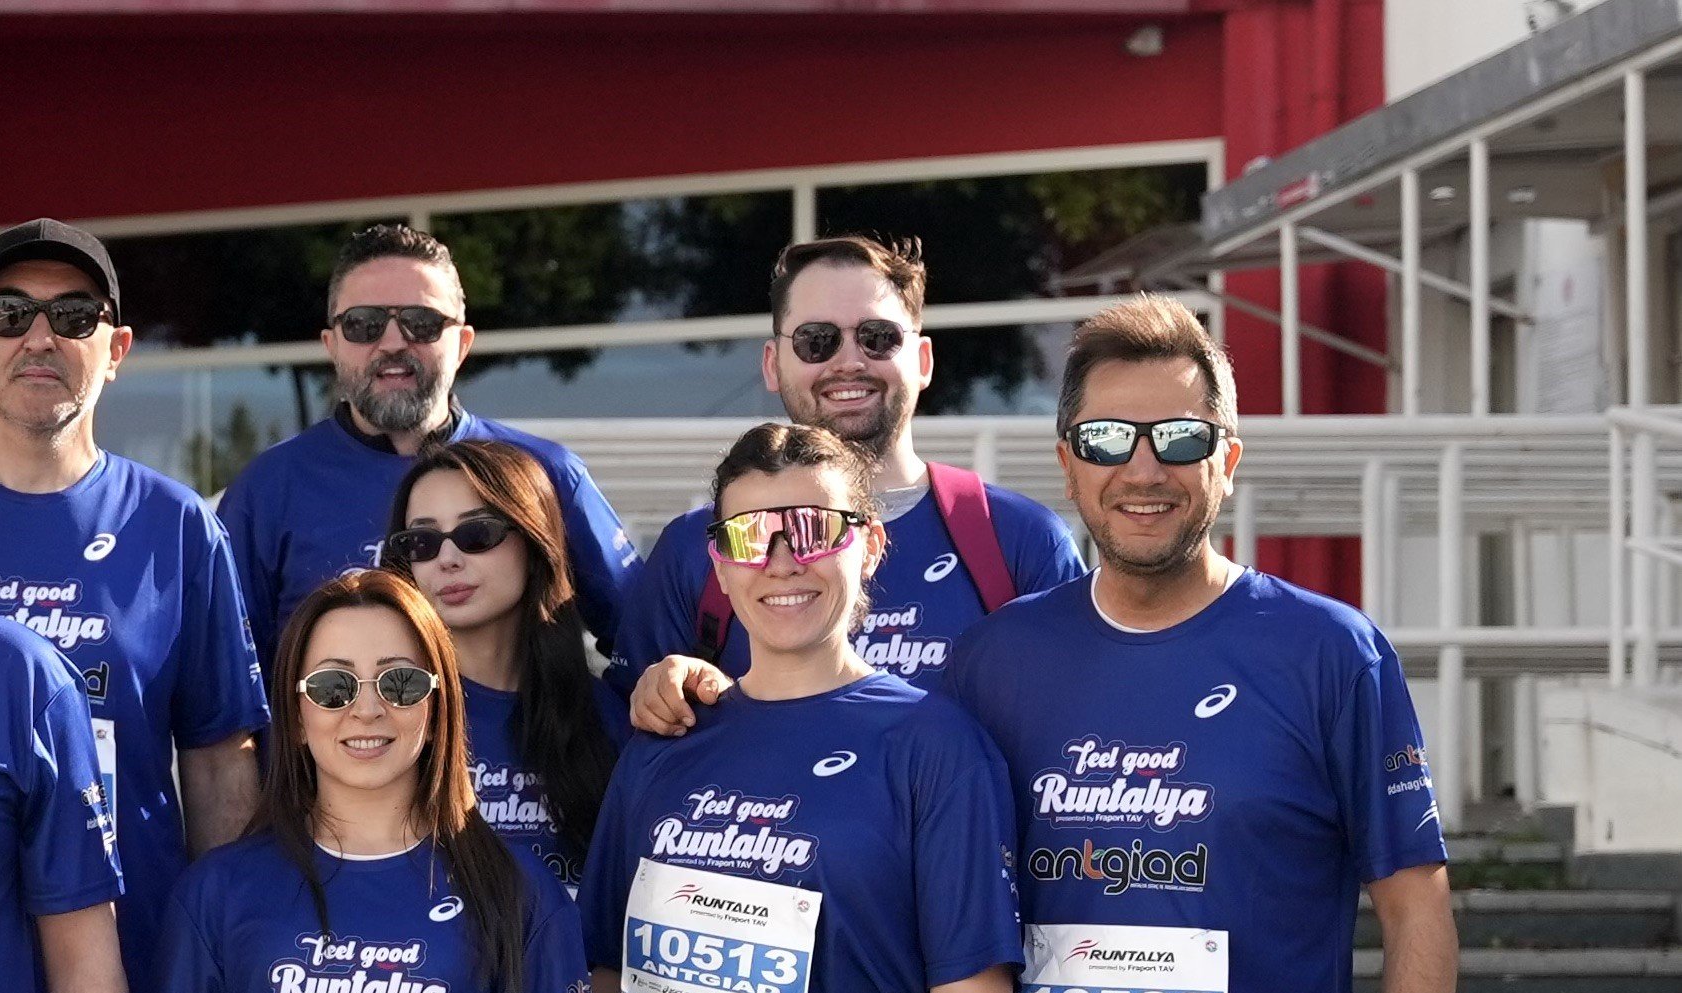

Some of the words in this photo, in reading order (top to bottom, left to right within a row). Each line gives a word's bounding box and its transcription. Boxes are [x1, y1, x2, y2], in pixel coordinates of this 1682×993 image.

[22, 584, 76, 606] good
[863, 607, 918, 633] good
[850, 634, 947, 676] talya
[1122, 747, 1181, 776] good
[736, 799, 794, 822] good
[1033, 773, 1207, 826] Runtalya
[1096, 814, 1125, 822] Fraport
[653, 818, 813, 874] Runtalya
[707, 858, 735, 868] Fraport
[736, 859, 754, 869] TAV
[1028, 838, 1207, 895] antgiad
[691, 895, 769, 918] RUNTALYA
[360, 944, 420, 968] good
[634, 923, 798, 985] 10513
[1089, 949, 1175, 963] RUNTALYA
[1128, 964, 1156, 972] Fraport
